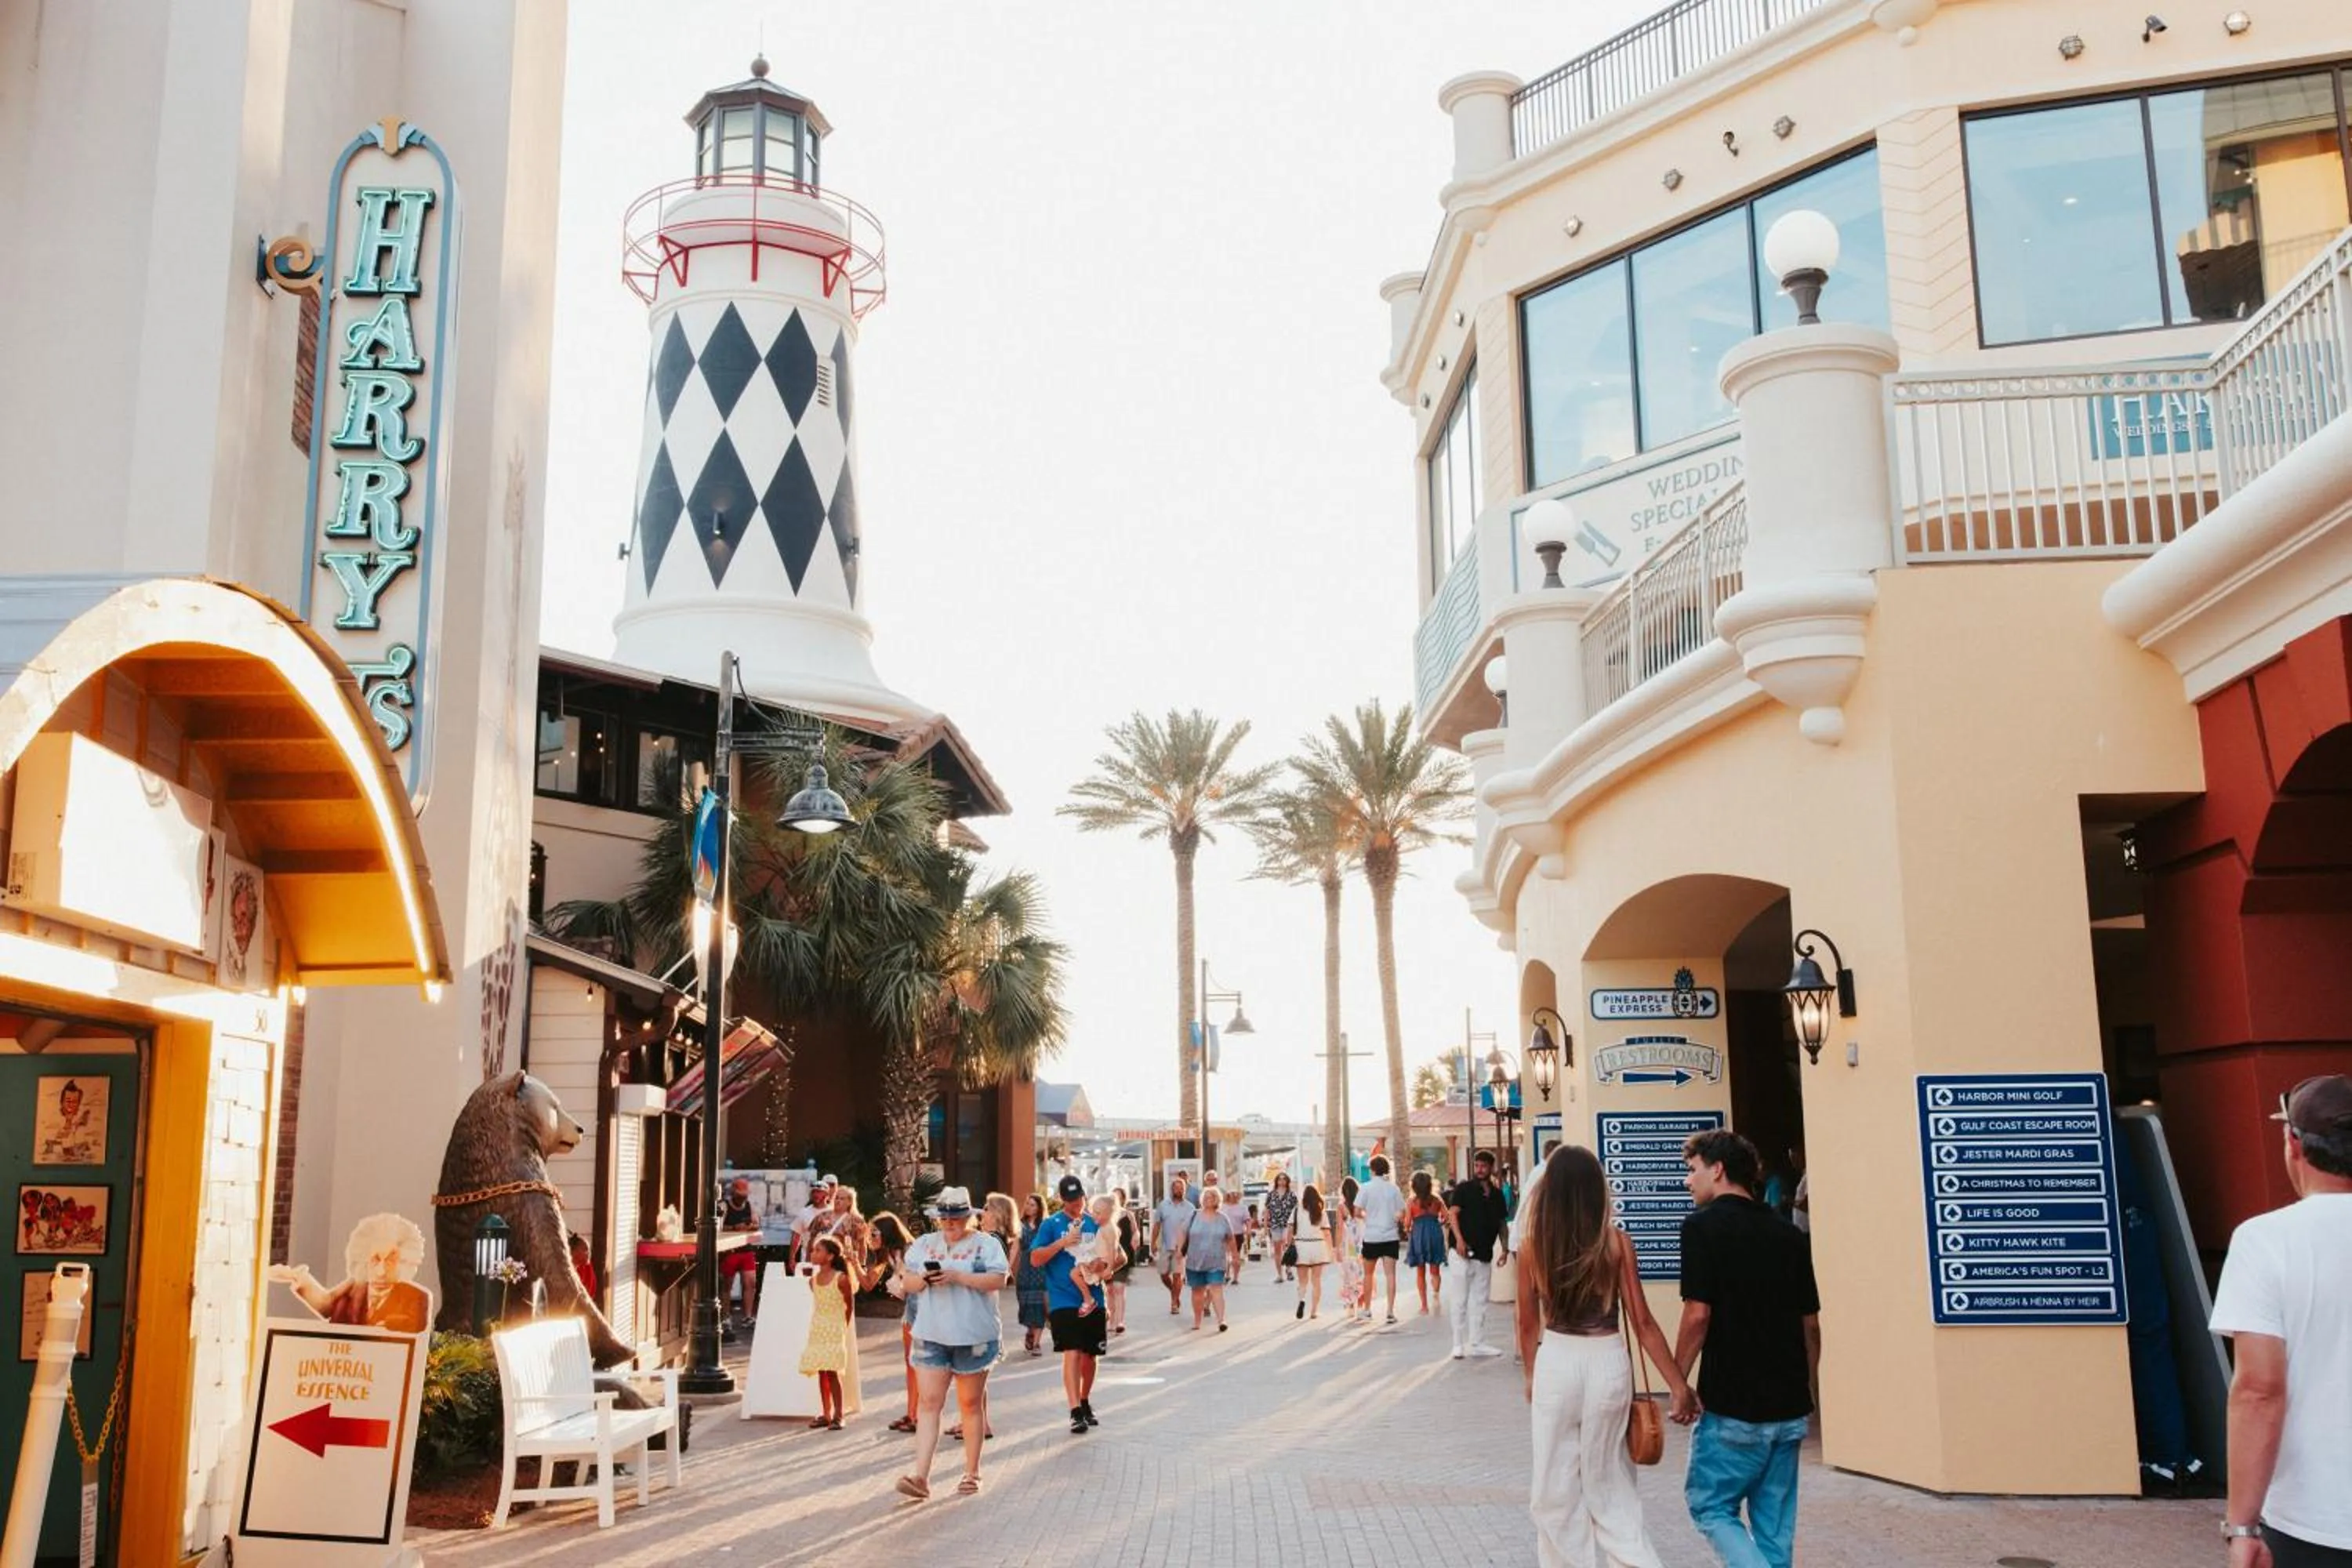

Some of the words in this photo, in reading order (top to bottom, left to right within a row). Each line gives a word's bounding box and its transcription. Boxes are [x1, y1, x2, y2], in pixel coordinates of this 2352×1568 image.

[318, 186, 436, 630] HARRY
[1631, 488, 1719, 533] SPECIA
[1602, 994, 1669, 1004] PINEAPPLE
[1610, 1004, 1663, 1014] EXPRESS
[1958, 1091, 2005, 1102] HARBOR
[2007, 1091, 2031, 1101] MINI
[2033, 1091, 2063, 1101] GOLF
[1960, 1121, 1987, 1131] GULF
[1988, 1121, 2023, 1131] COAST
[2024, 1120, 2063, 1130] ESCAPE
[2065, 1120, 2096, 1129] ROOM
[1962, 1150, 2003, 1160] JESTER
[2005, 1149, 2041, 1159] MARDI
[2044, 1149, 2074, 1158] GRAS
[1962, 1179, 1969, 1188] A
[1970, 1179, 2026, 1189] CHRISTMAS
[2027, 1179, 2042, 1188] TO
[2043, 1178, 2096, 1188] REMEMBER
[1966, 1208, 1991, 1218] LIFE
[1993, 1208, 2003, 1218] IS
[2007, 1208, 2040, 1218] GOOD
[1969, 1238, 2001, 1247] KITTY
[2003, 1238, 2040, 1247] HAWK
[2041, 1237, 2067, 1247] KITE
[1972, 1265, 2029, 1276] AMERICA'S
[2031, 1265, 2053, 1276] FUN
[2055, 1265, 2082, 1276] SPOT
[2092, 1265, 2104, 1276] L2
[1973, 1297, 2020, 1306] AIRBRUSH
[2021, 1297, 2028, 1306] &
[2030, 1296, 2062, 1306] HENNA
[2063, 1296, 2076, 1305] BY
[328, 1341, 353, 1355] THE
[298, 1356, 375, 1382] UNIVERSAL
[295, 1381, 372, 1401] ESSENCE
